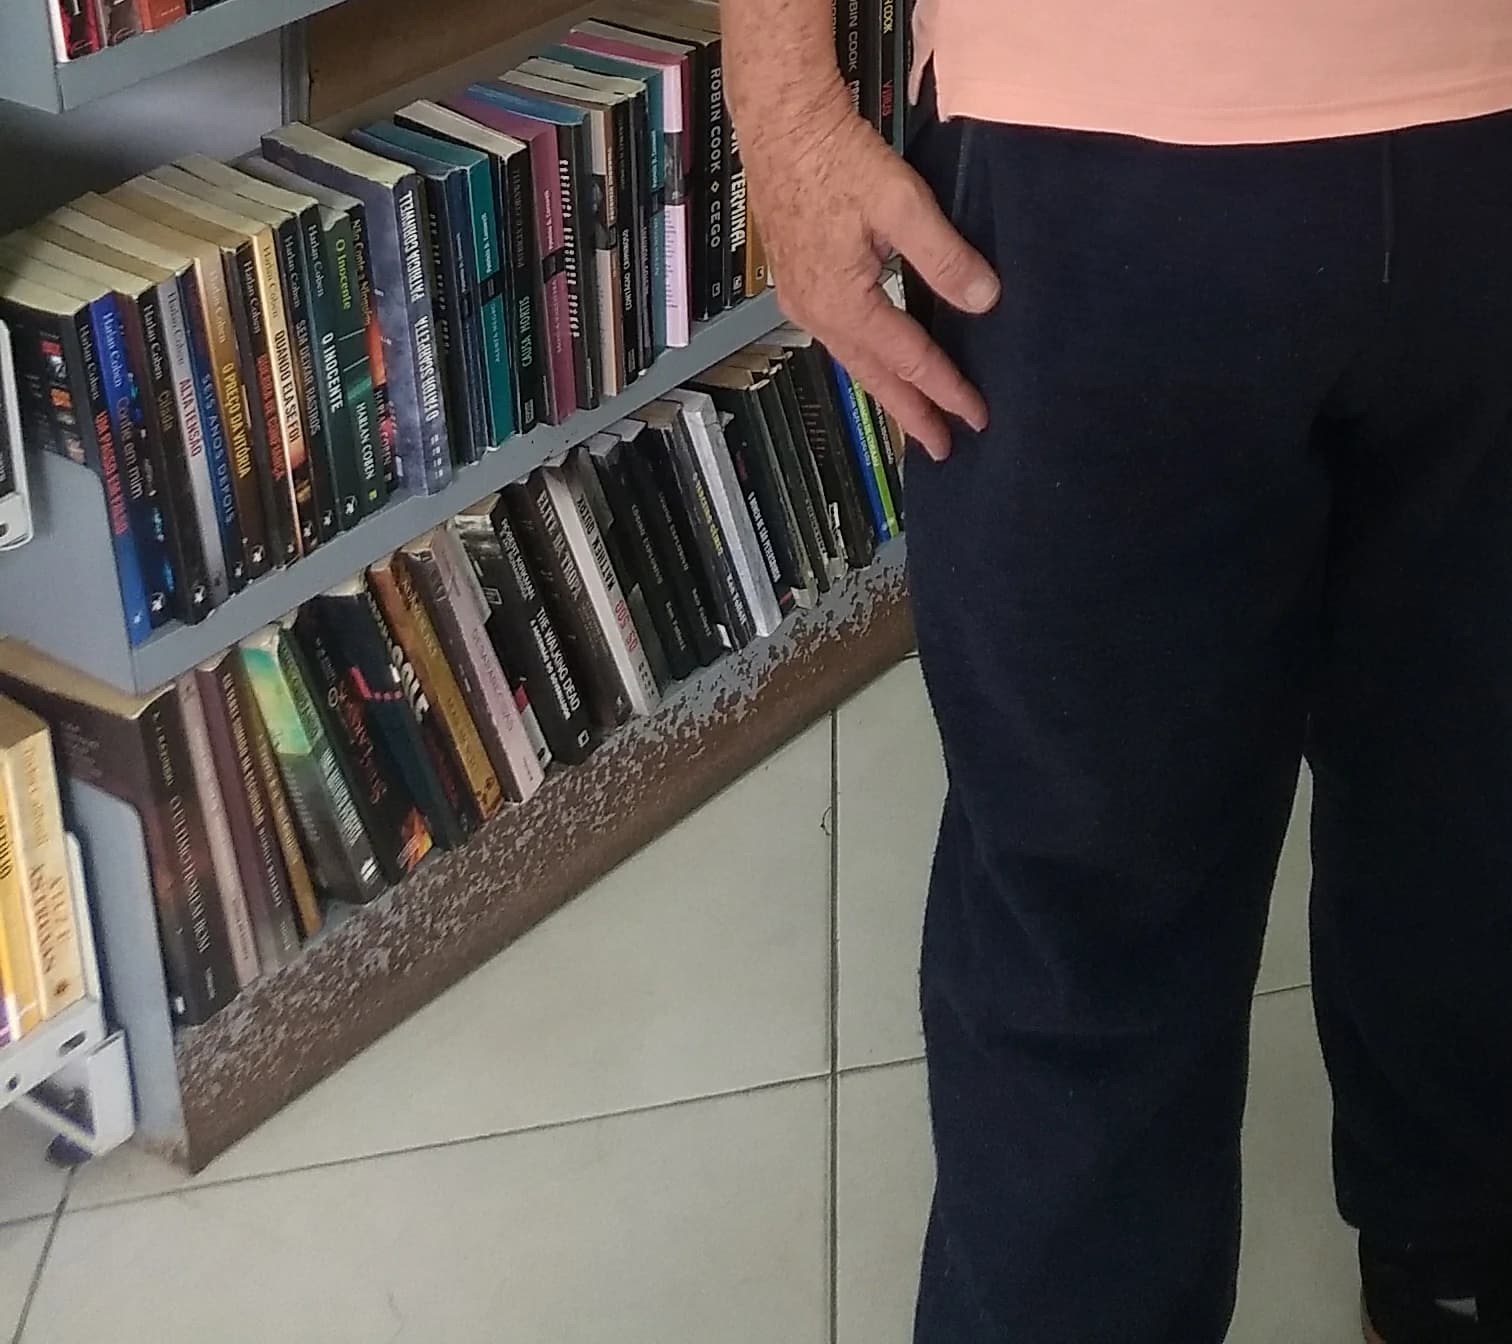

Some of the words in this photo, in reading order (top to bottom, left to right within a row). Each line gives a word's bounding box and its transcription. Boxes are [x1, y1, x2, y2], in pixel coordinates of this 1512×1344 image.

[883, 7, 893, 34] COOK
[849, 30, 858, 71] COOK
[708, 67, 722, 116] ROBIN
[709, 124, 721, 174] COOK
[400, 190, 418, 247] CORNWELL
[709, 199, 722, 250] CEGO
[729, 168, 749, 253] TERMINAL
[335, 239, 346, 251] O
[337, 253, 352, 310] Inocente
[406, 249, 425, 303] PATRICIA
[519, 296, 531, 331] MORTIS
[322, 332, 333, 344] O
[521, 332, 535, 368] CAUSA
[179, 379, 195, 412] ALTA
[324, 347, 344, 413] INOCENTE
[185, 415, 201, 458] TENSÃO
[356, 402, 369, 441] HARLAN
[362, 442, 375, 481] COBEN
[537, 606, 548, 626] THE
[543, 626, 568, 680] WALKING
[563, 677, 581, 712] DEAD
